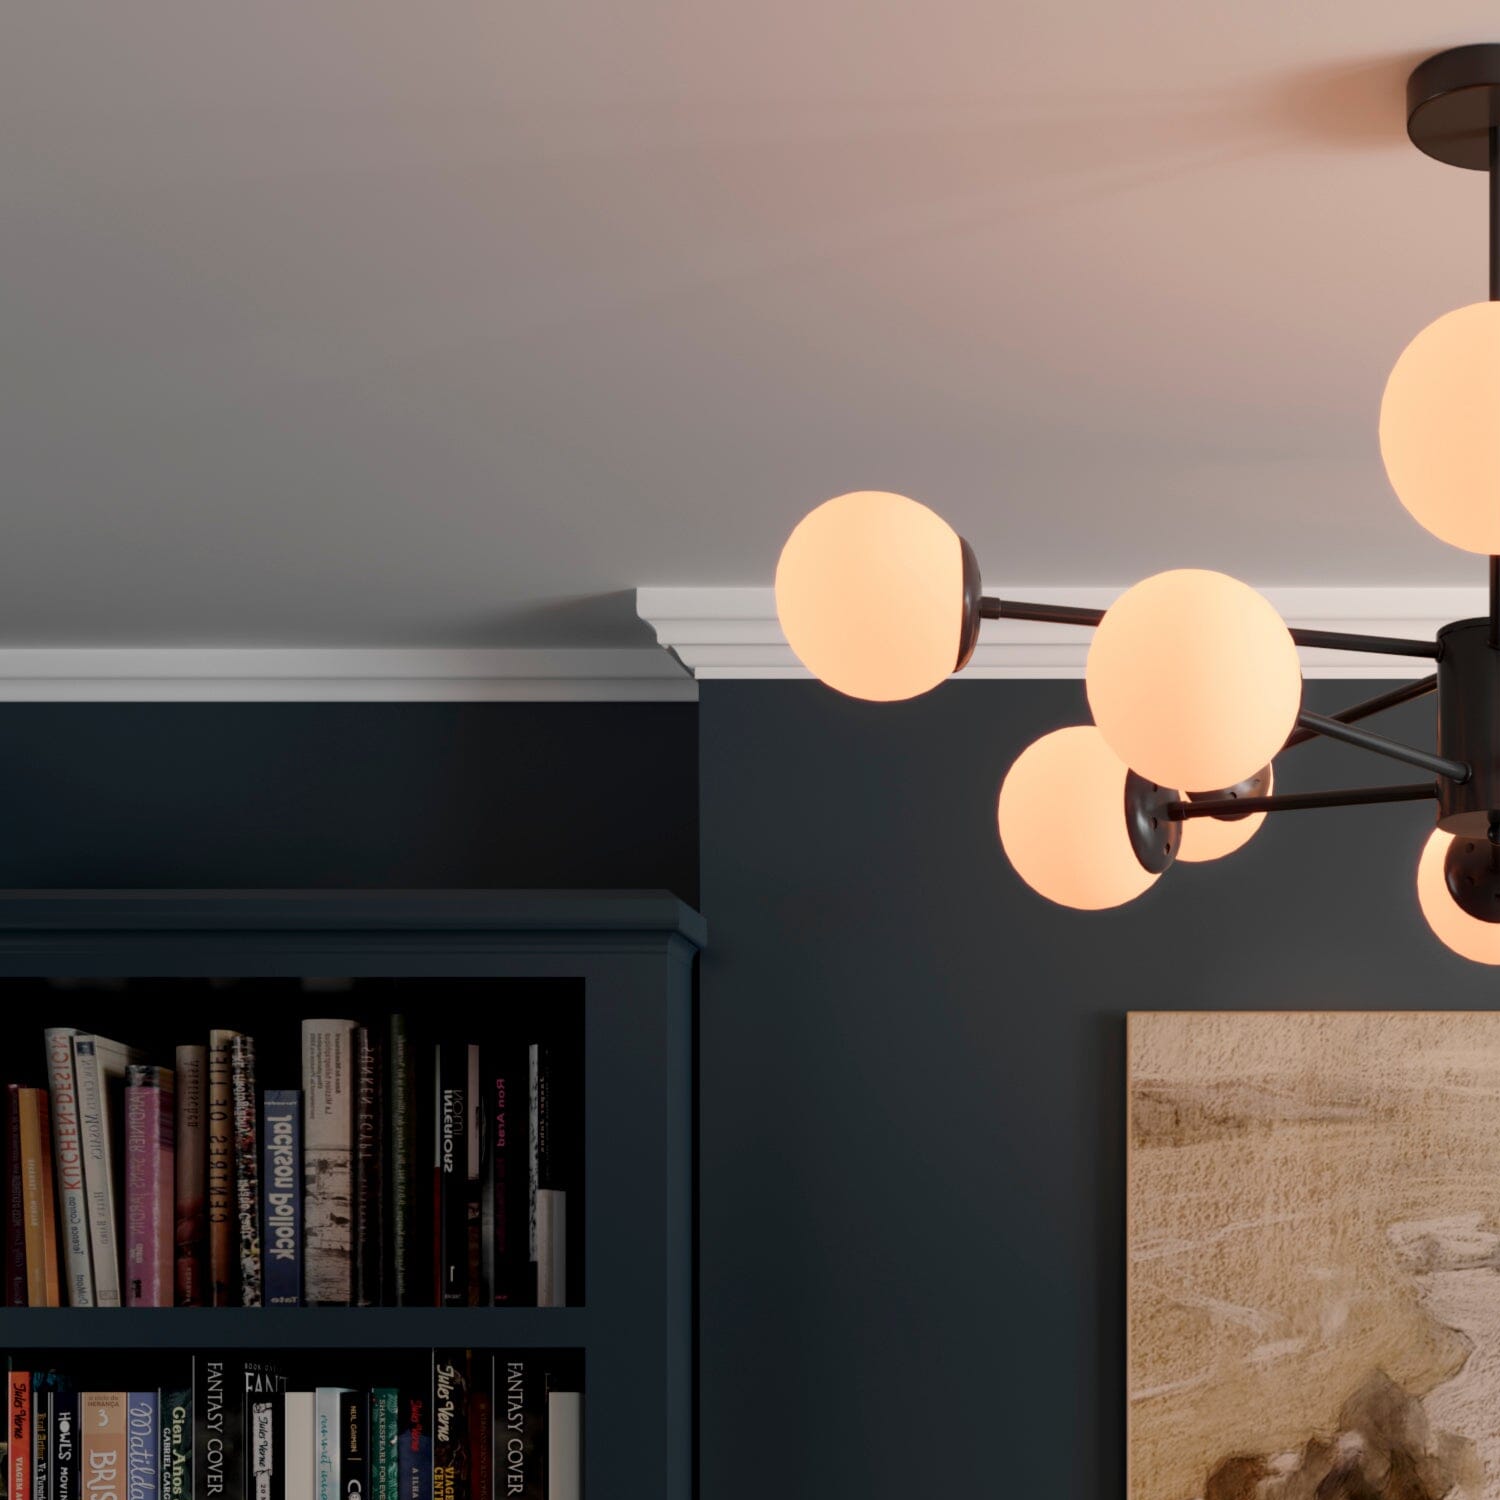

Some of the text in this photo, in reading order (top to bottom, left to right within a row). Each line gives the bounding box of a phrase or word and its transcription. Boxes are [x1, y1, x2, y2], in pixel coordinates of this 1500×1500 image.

[57, 1412, 72, 1461] HOWL'S
[207, 1362, 224, 1496] FANTASY COVER
[436, 1364, 455, 1442] Jules Verne
[507, 1362, 524, 1496] FANTASY COVER
[15, 1457, 24, 1490] VIAGEM
